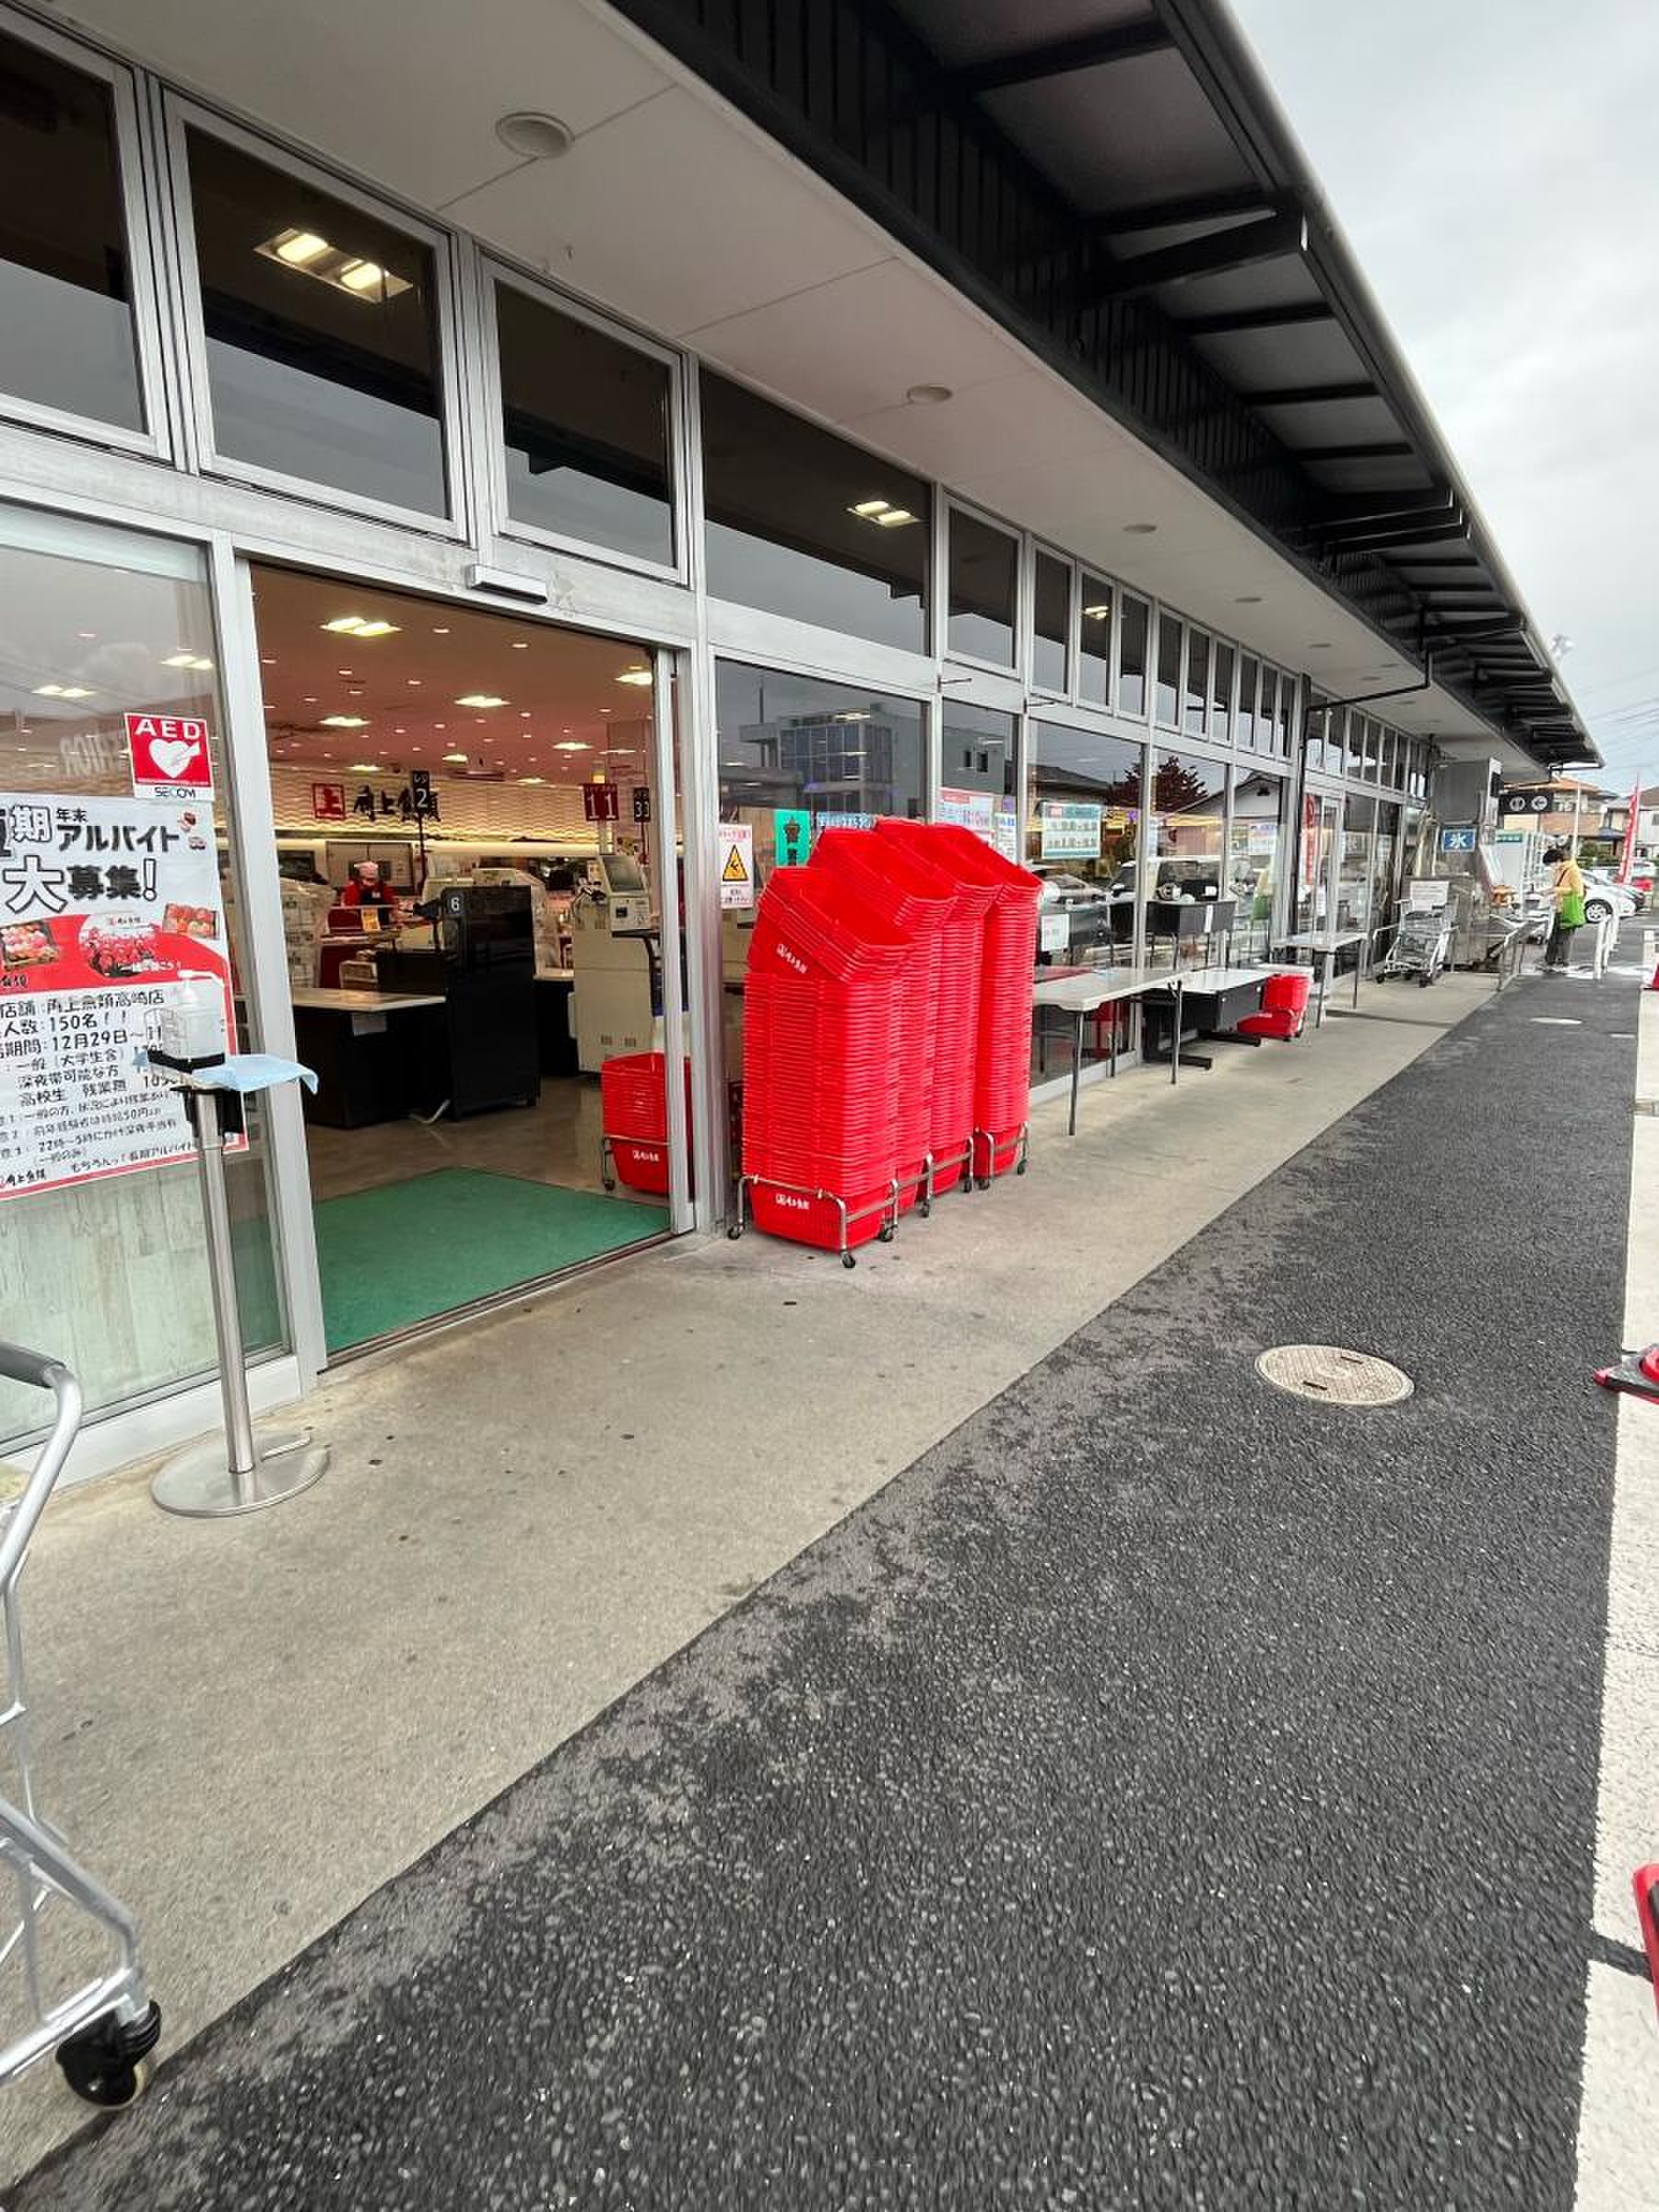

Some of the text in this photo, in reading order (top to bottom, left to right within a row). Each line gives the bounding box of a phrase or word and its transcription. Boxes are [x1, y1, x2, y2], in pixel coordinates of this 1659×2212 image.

[135, 718, 202, 739] AED
[415, 787, 428, 808] 2
[55, 808, 88, 822] 年末
[56, 825, 180, 853] アルバイト
[1449, 832, 1467, 849] 氷
[3, 854, 158, 914] 大募集!
